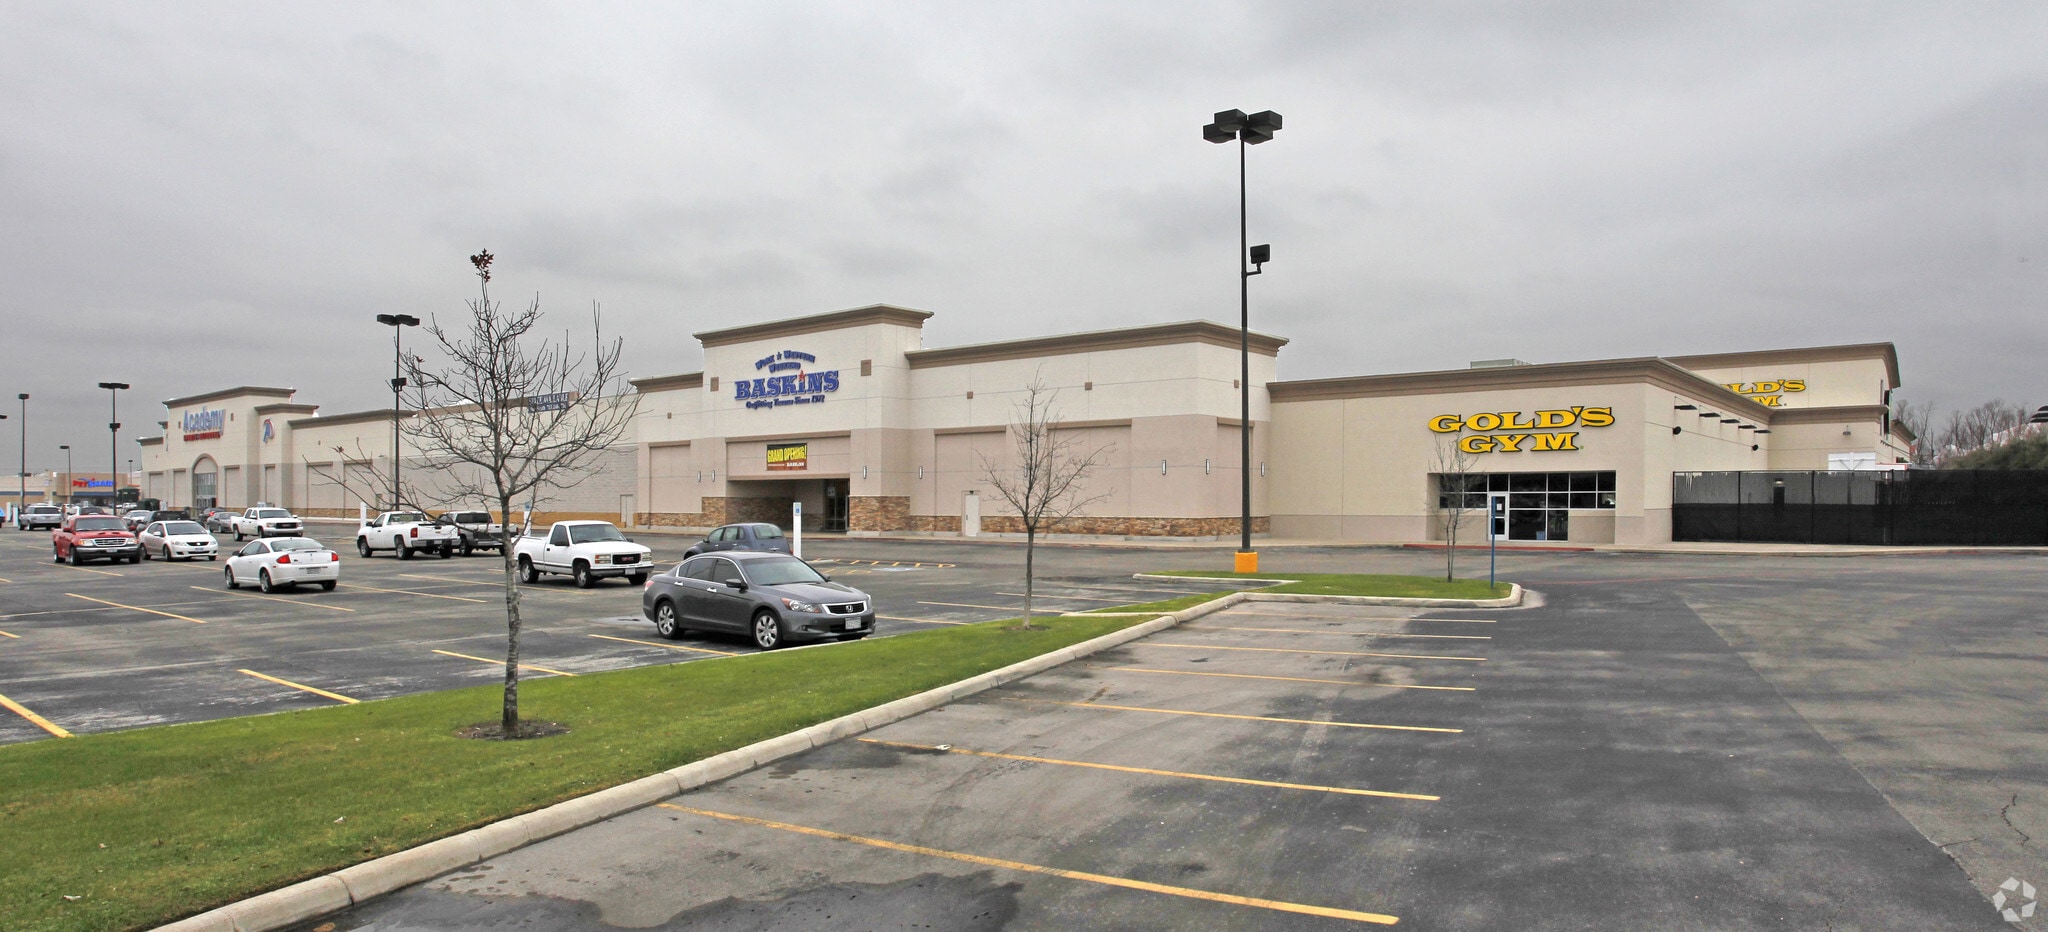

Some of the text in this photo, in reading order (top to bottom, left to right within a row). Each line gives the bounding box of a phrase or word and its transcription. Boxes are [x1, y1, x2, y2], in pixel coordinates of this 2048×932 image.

[735, 370, 839, 399] BASKINS
[183, 406, 226, 436] Academy
[1428, 406, 1615, 433] GOLD'S
[767, 449, 783, 463] GRAND
[1458, 432, 1580, 454] GYM
